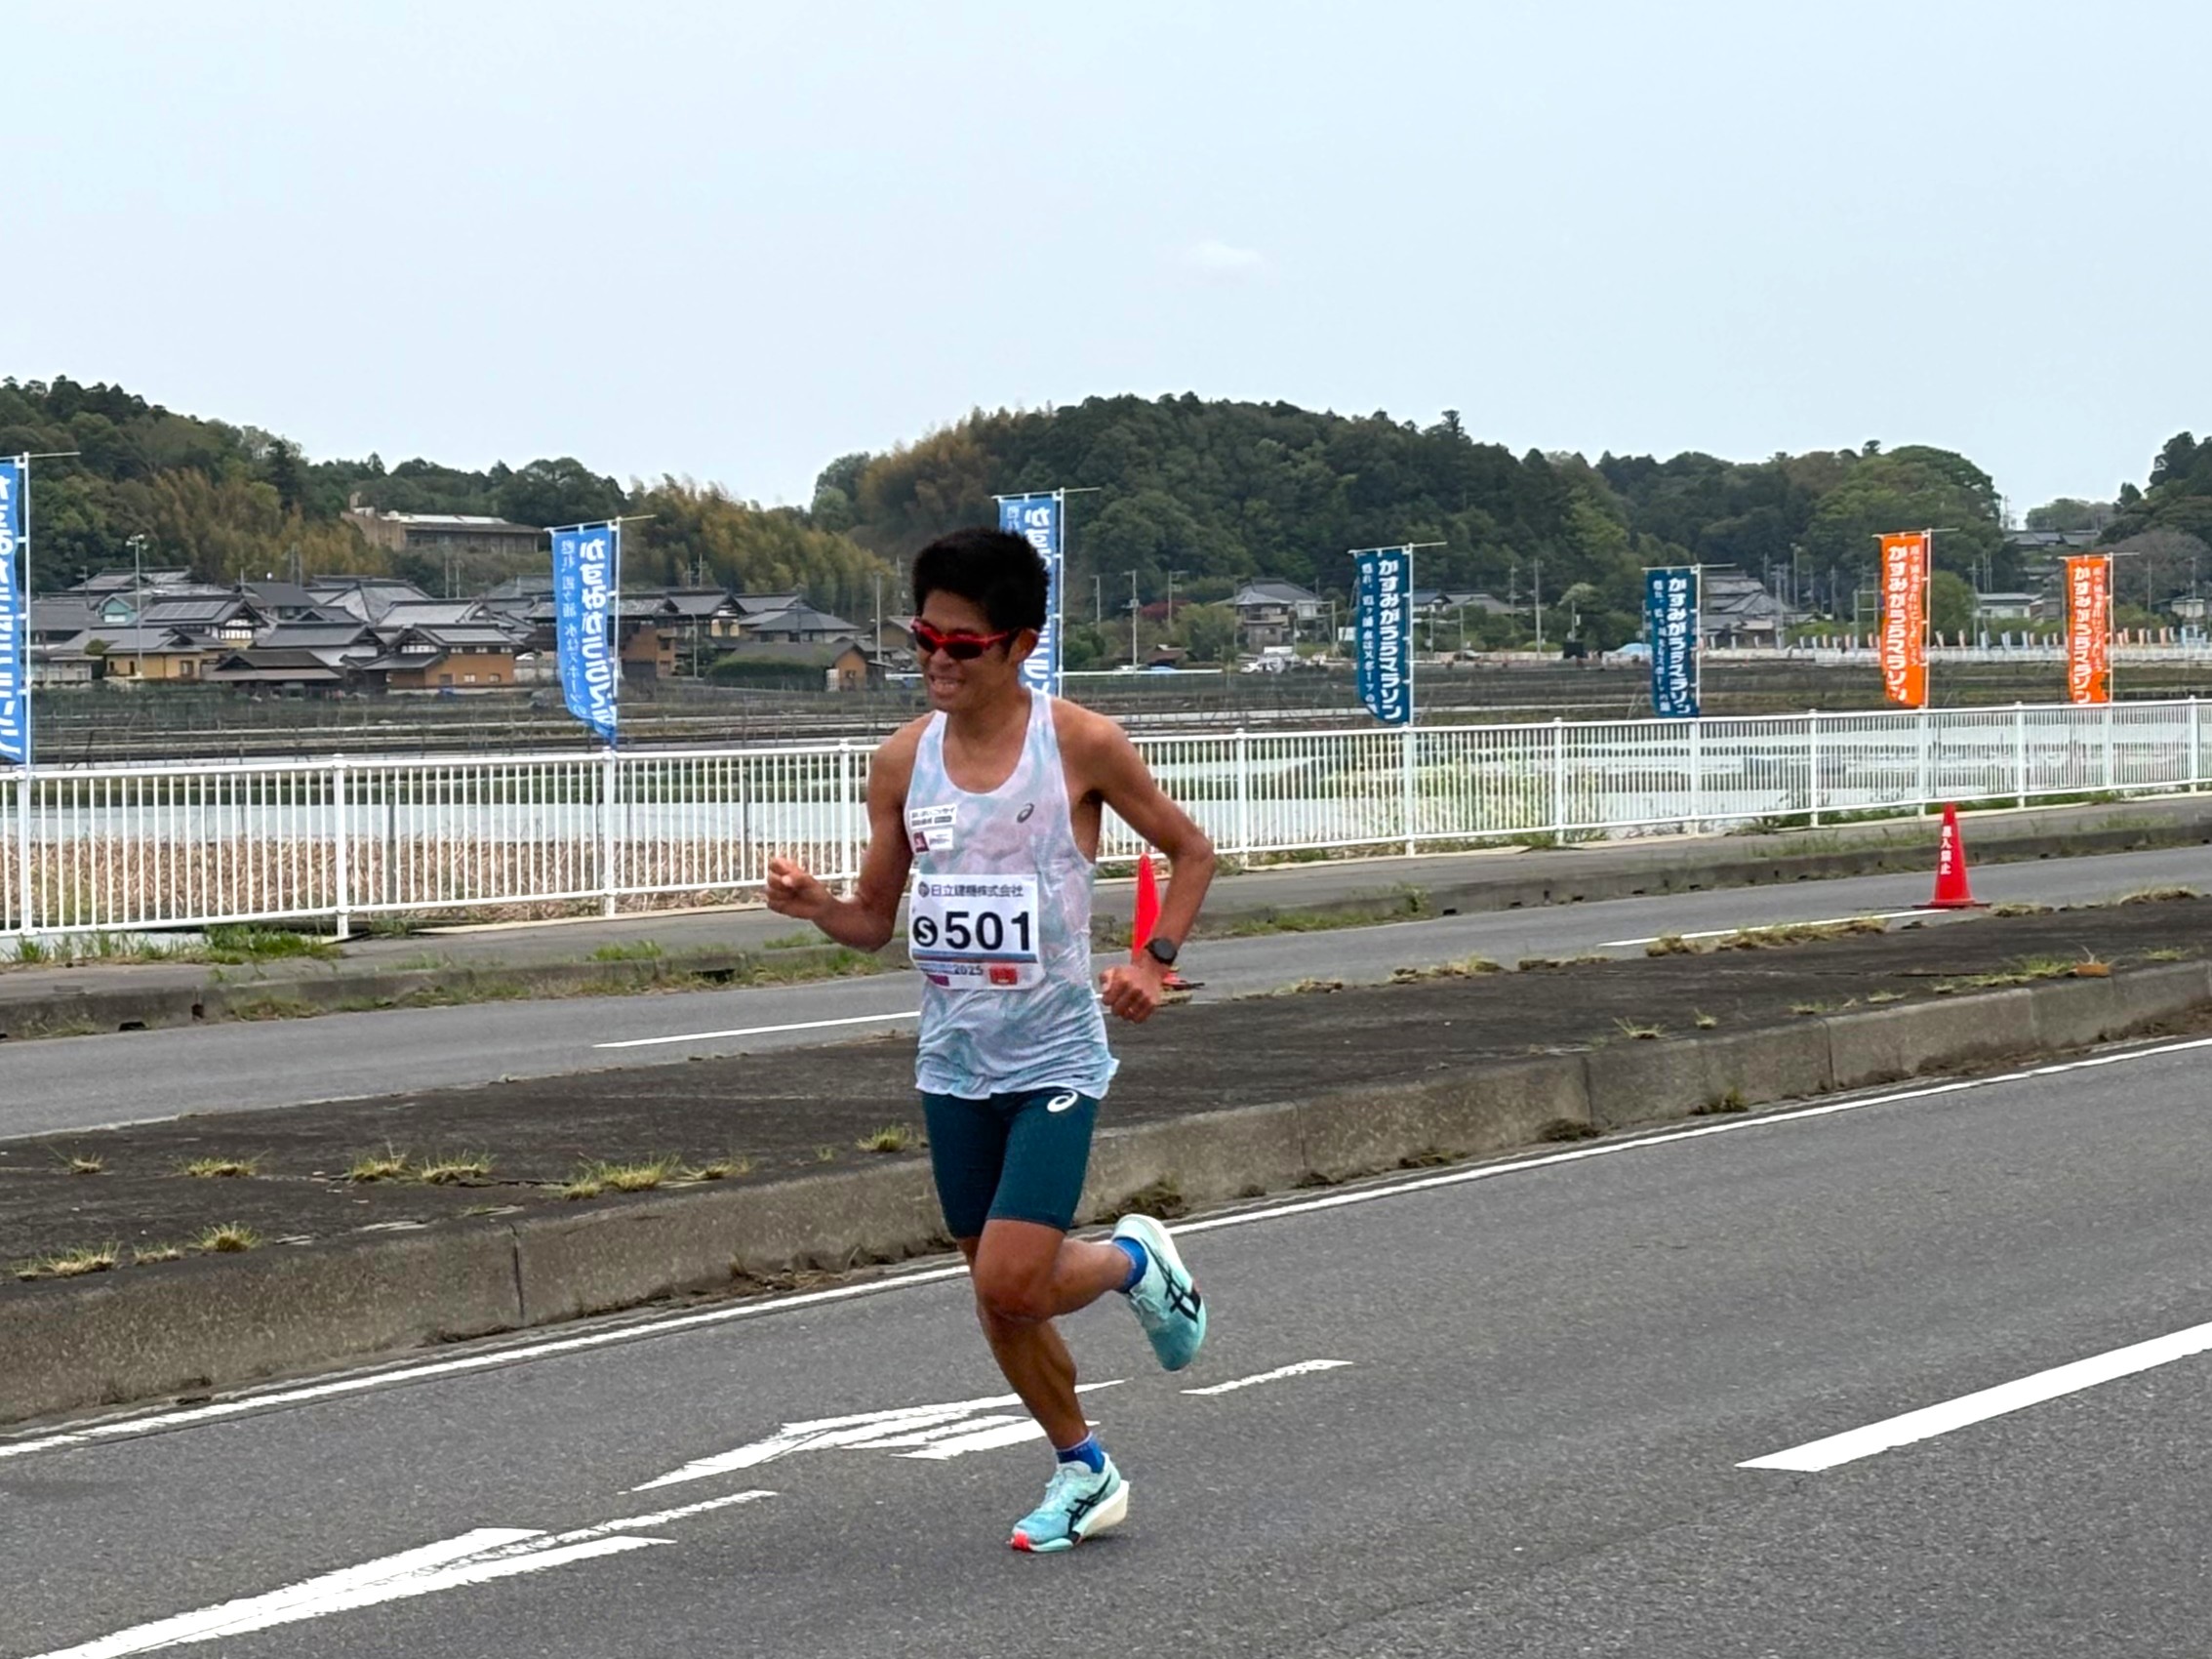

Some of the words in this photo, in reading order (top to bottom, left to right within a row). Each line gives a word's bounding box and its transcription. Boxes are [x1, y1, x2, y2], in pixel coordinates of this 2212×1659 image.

[1378, 559, 1402, 719] かすみがうらマラソン
[1668, 577, 1691, 714] かすみがうらマラソン
[1886, 546, 1908, 702] かすみがうらマラソン
[2073, 566, 2092, 705] かすみがうらマラソン
[931, 884, 1024, 897] 日立建機株式会社
[945, 910, 1030, 951] 501
[953, 965, 984, 976] 2025
